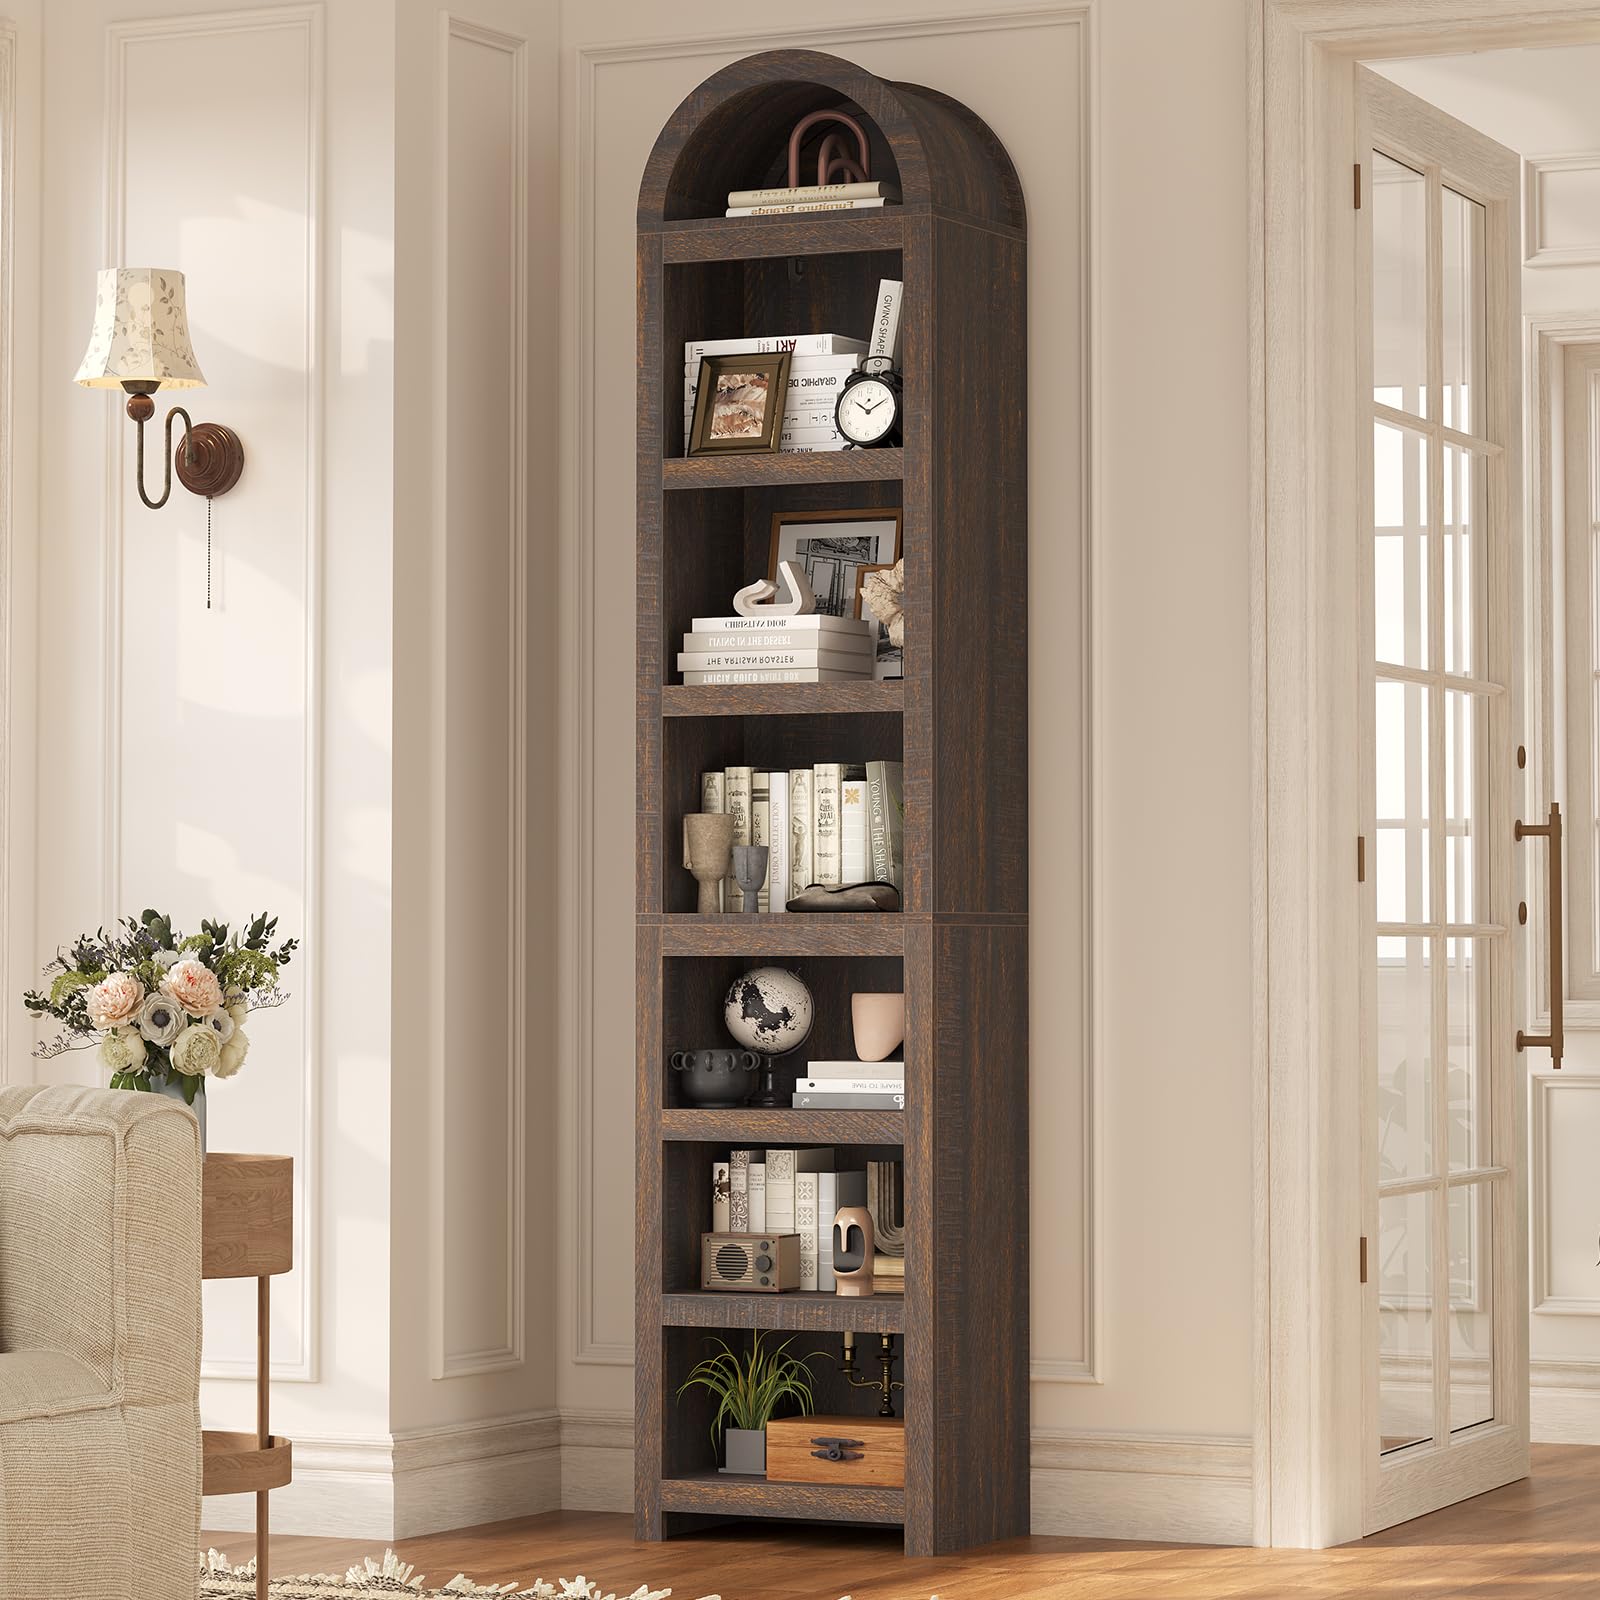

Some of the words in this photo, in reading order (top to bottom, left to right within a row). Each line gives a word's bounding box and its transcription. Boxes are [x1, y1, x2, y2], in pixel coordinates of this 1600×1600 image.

[880, 295, 893, 326] GIVING
[775, 339, 797, 352] ART
[876, 327, 888, 354] SHAPE
[801, 376, 837, 388] GRAPHIC
[870, 778, 882, 815] YOUNG
[771, 801, 780, 854] COLLECTION
[873, 824, 885, 846] THE
[771, 856, 781, 885] JUMBO
[874, 848, 888, 882] SHACK
